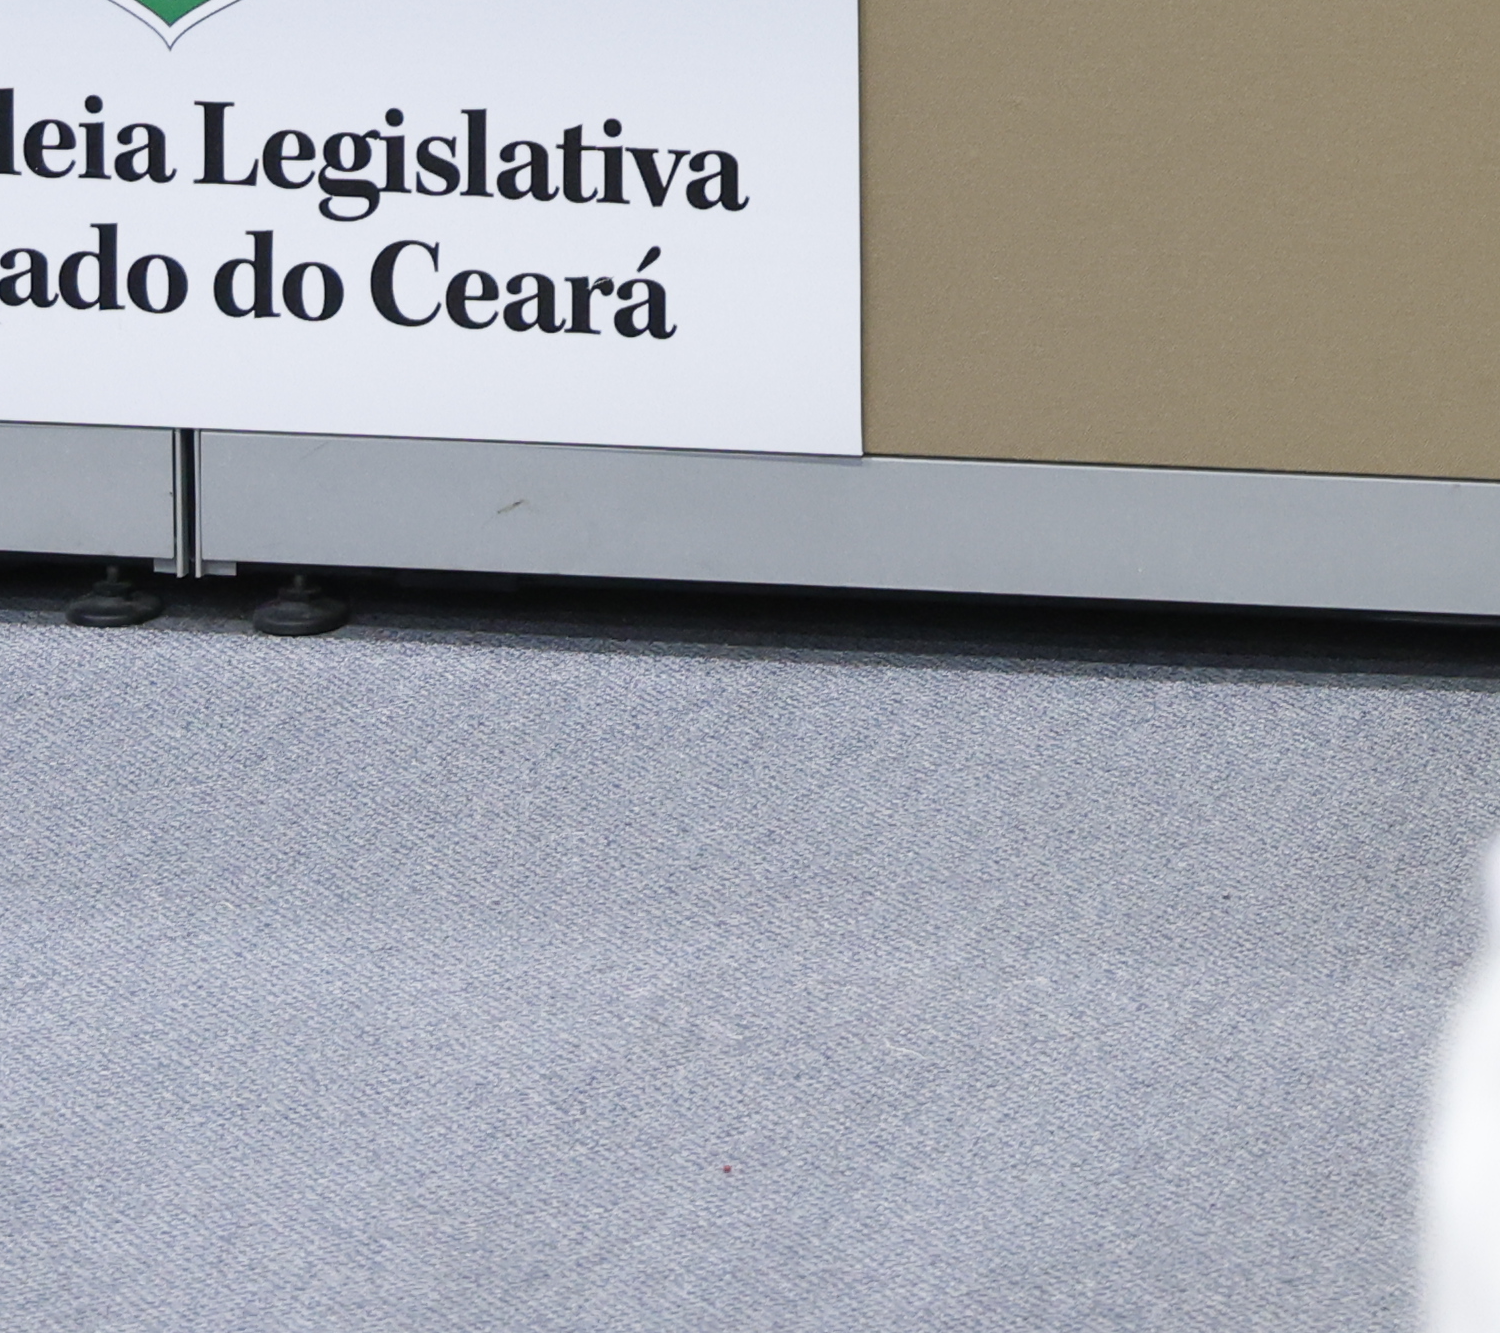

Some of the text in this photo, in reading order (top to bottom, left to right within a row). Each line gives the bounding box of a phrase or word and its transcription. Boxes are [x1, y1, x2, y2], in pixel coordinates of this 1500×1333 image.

[193, 100, 750, 222] Legislativa
[213, 230, 344, 322] do
[370, 240, 677, 340] Ceará
